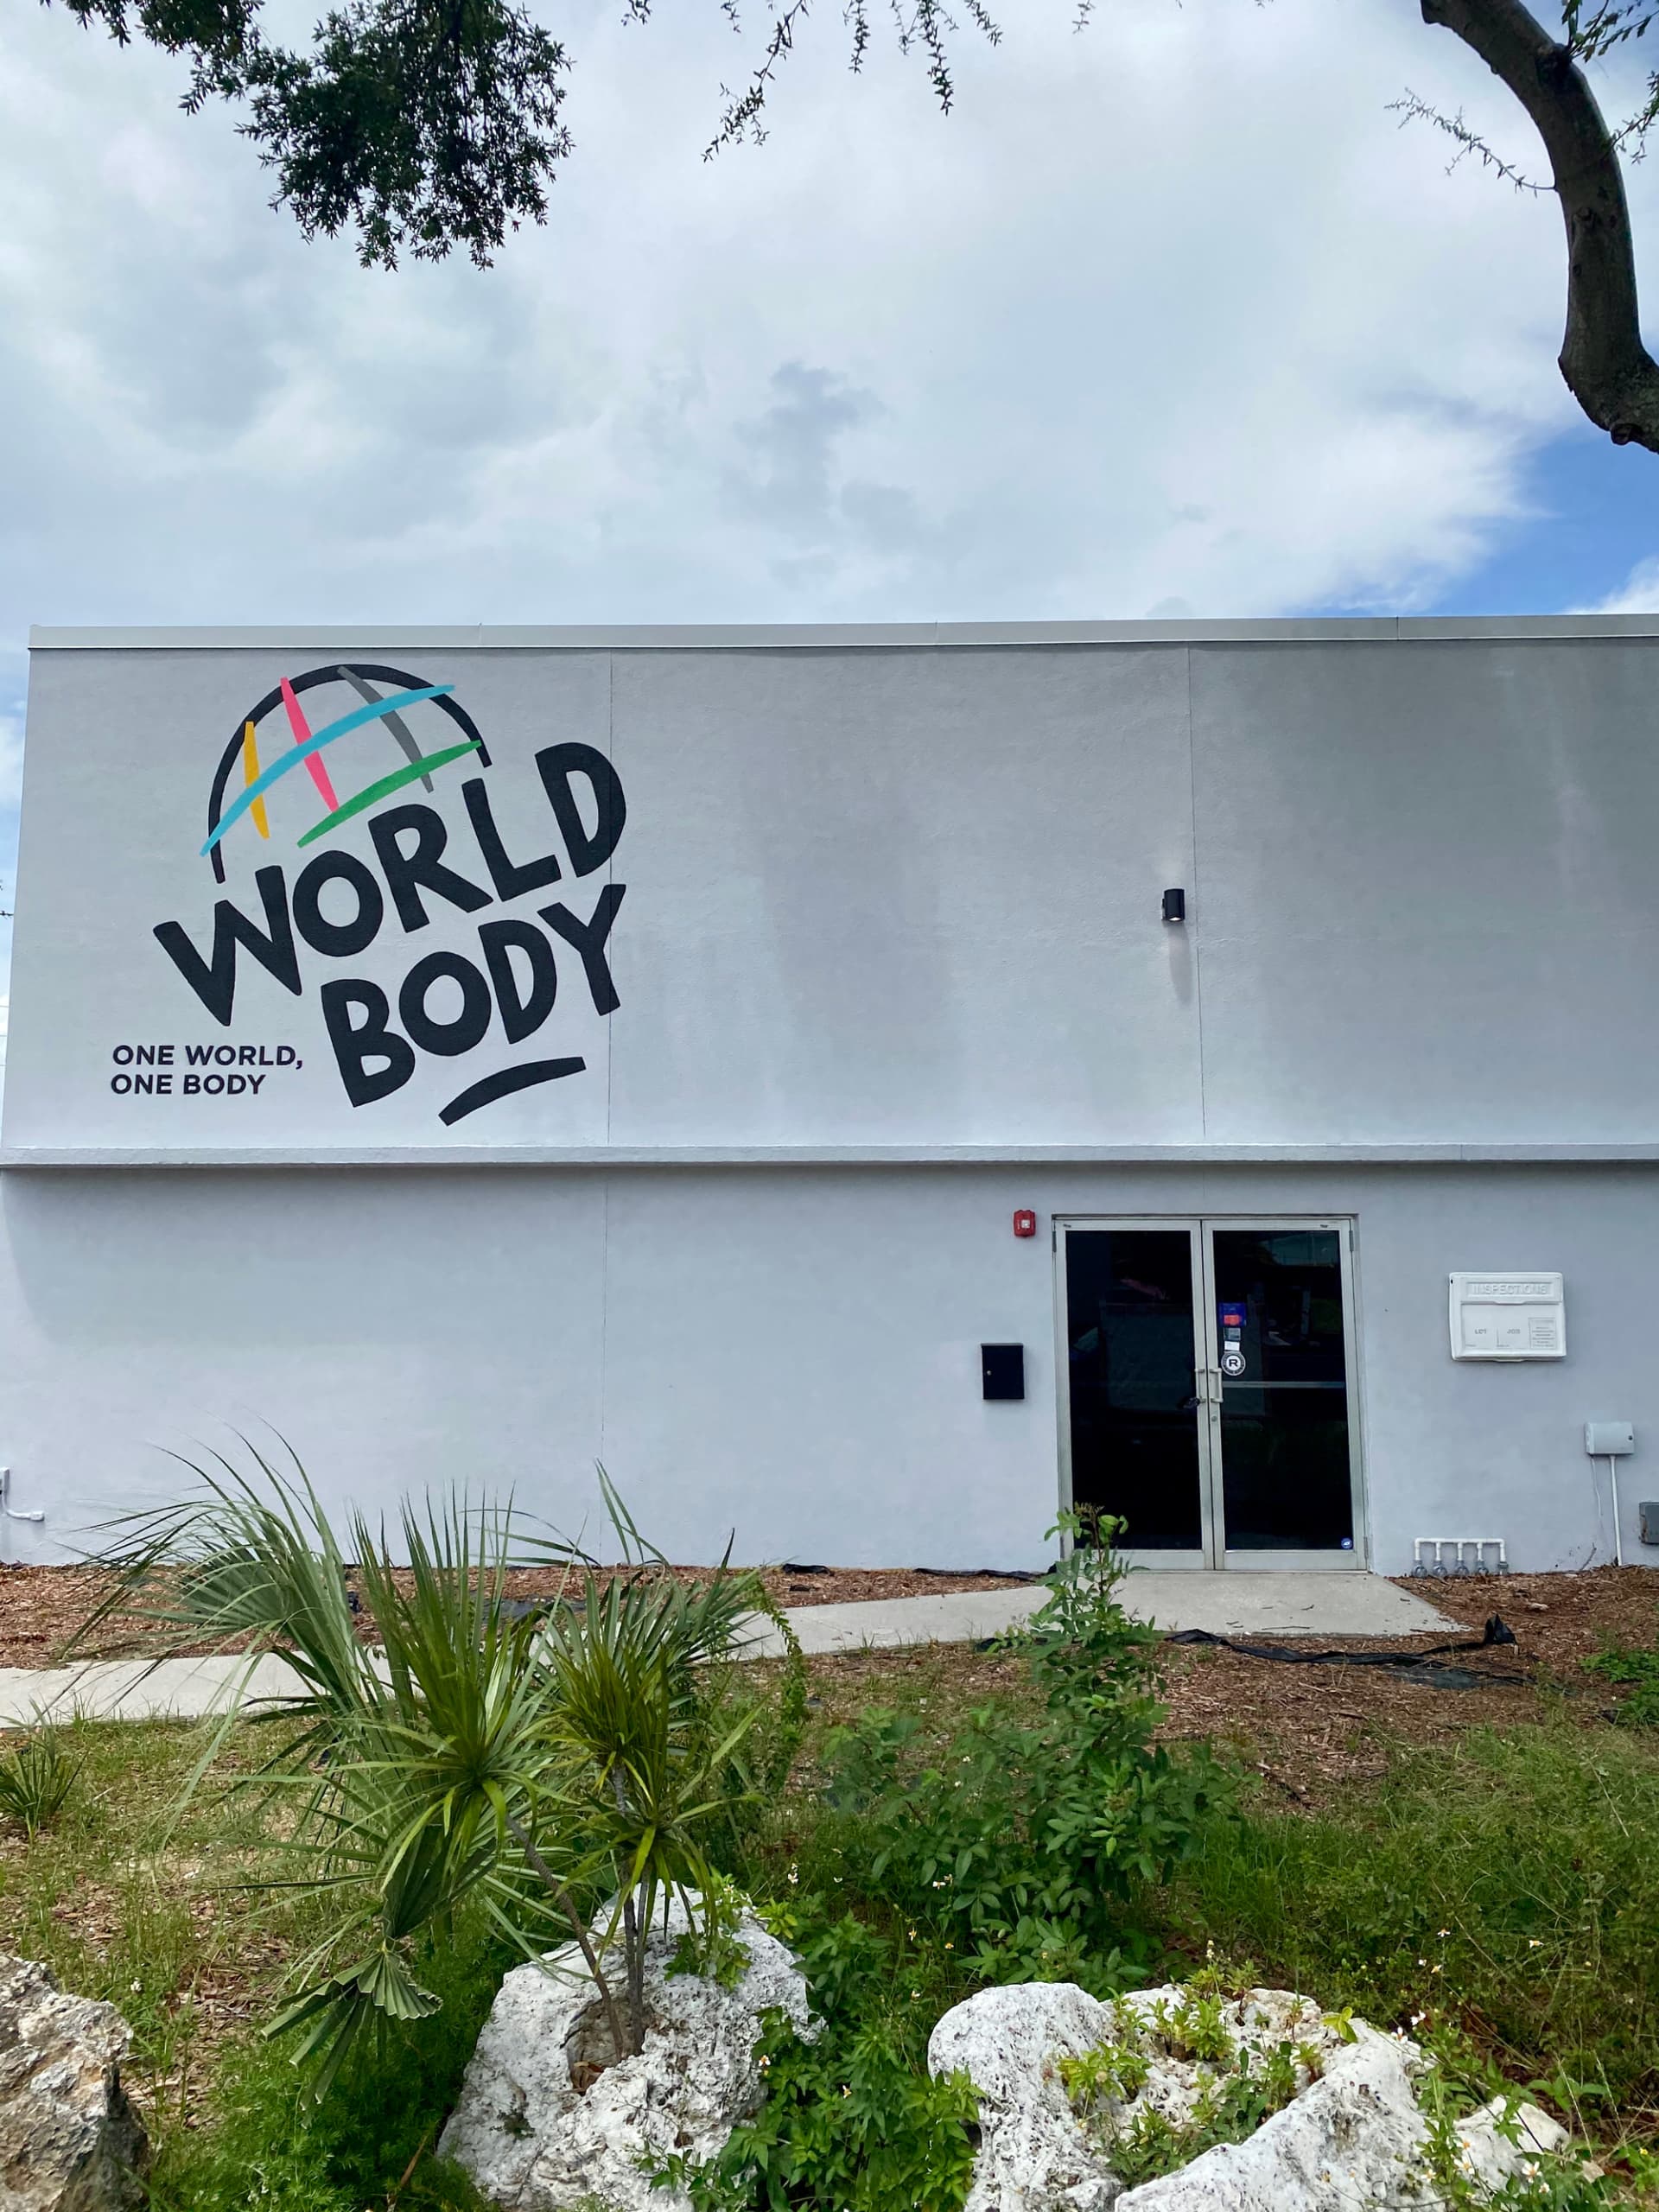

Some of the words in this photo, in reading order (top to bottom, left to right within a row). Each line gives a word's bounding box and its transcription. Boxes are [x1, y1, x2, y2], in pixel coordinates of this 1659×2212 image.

[153, 741, 626, 1027] WORLD
[112, 1045, 175, 1065] ONE
[185, 1045, 303, 1070] WORLD,
[321, 884, 626, 1108] BODY
[111, 1074, 173, 1095] ONE
[183, 1074, 266, 1095] BODY
